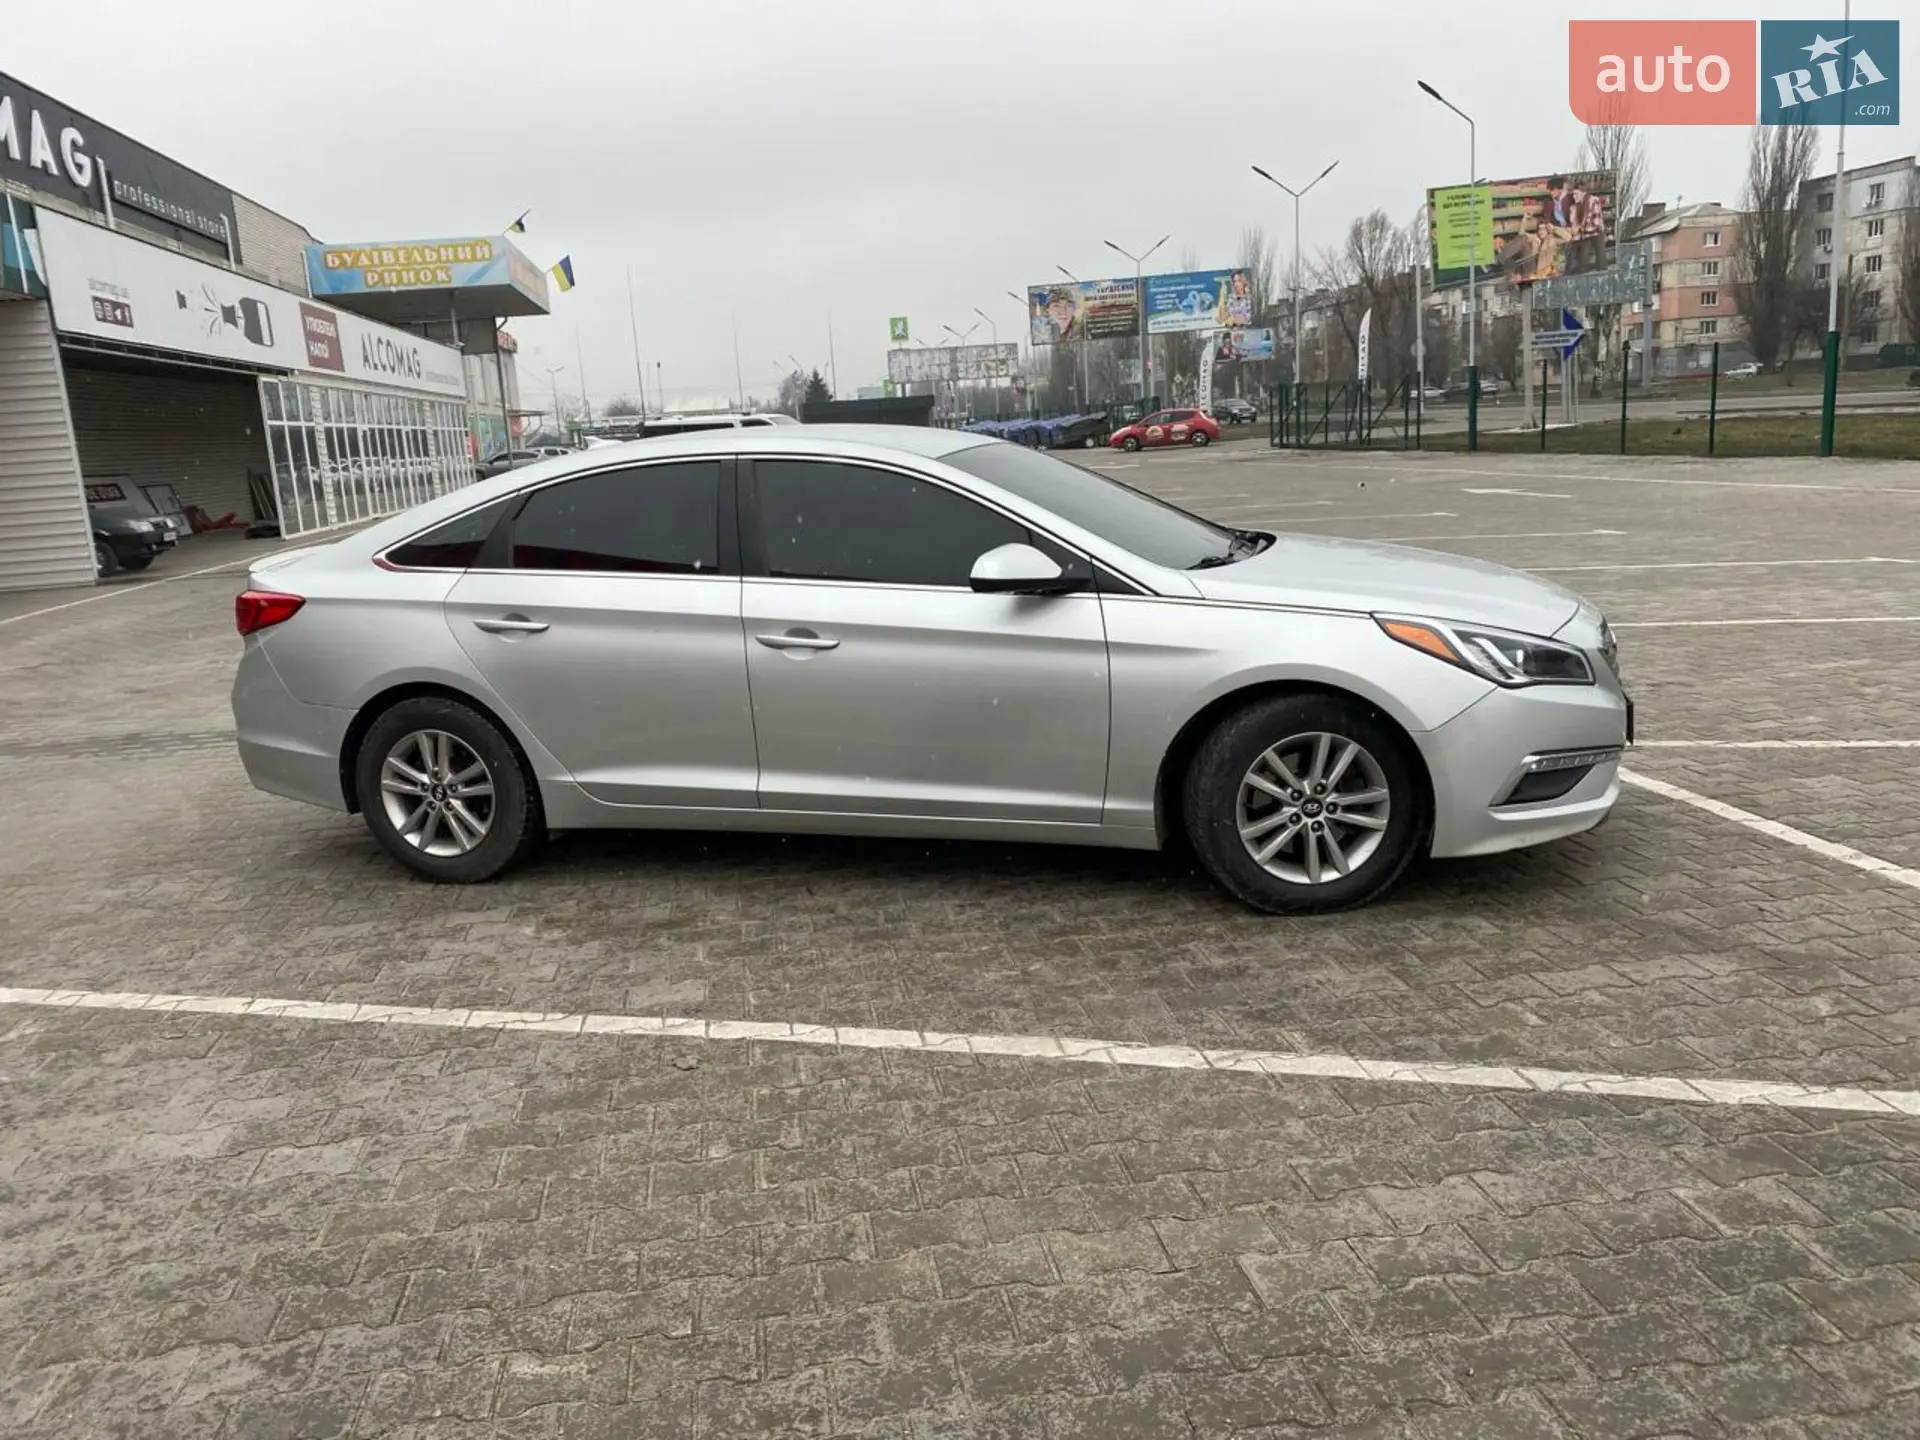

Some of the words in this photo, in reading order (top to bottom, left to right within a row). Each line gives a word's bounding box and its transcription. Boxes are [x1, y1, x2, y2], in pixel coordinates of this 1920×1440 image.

[114, 180, 195, 225] professional
[197, 215, 226, 239] store
[325, 241, 491, 268] БУДІВЕЛЬНИЙ
[365, 267, 451, 287] РИНОК
[361, 332, 421, 379] ALCOMAG
